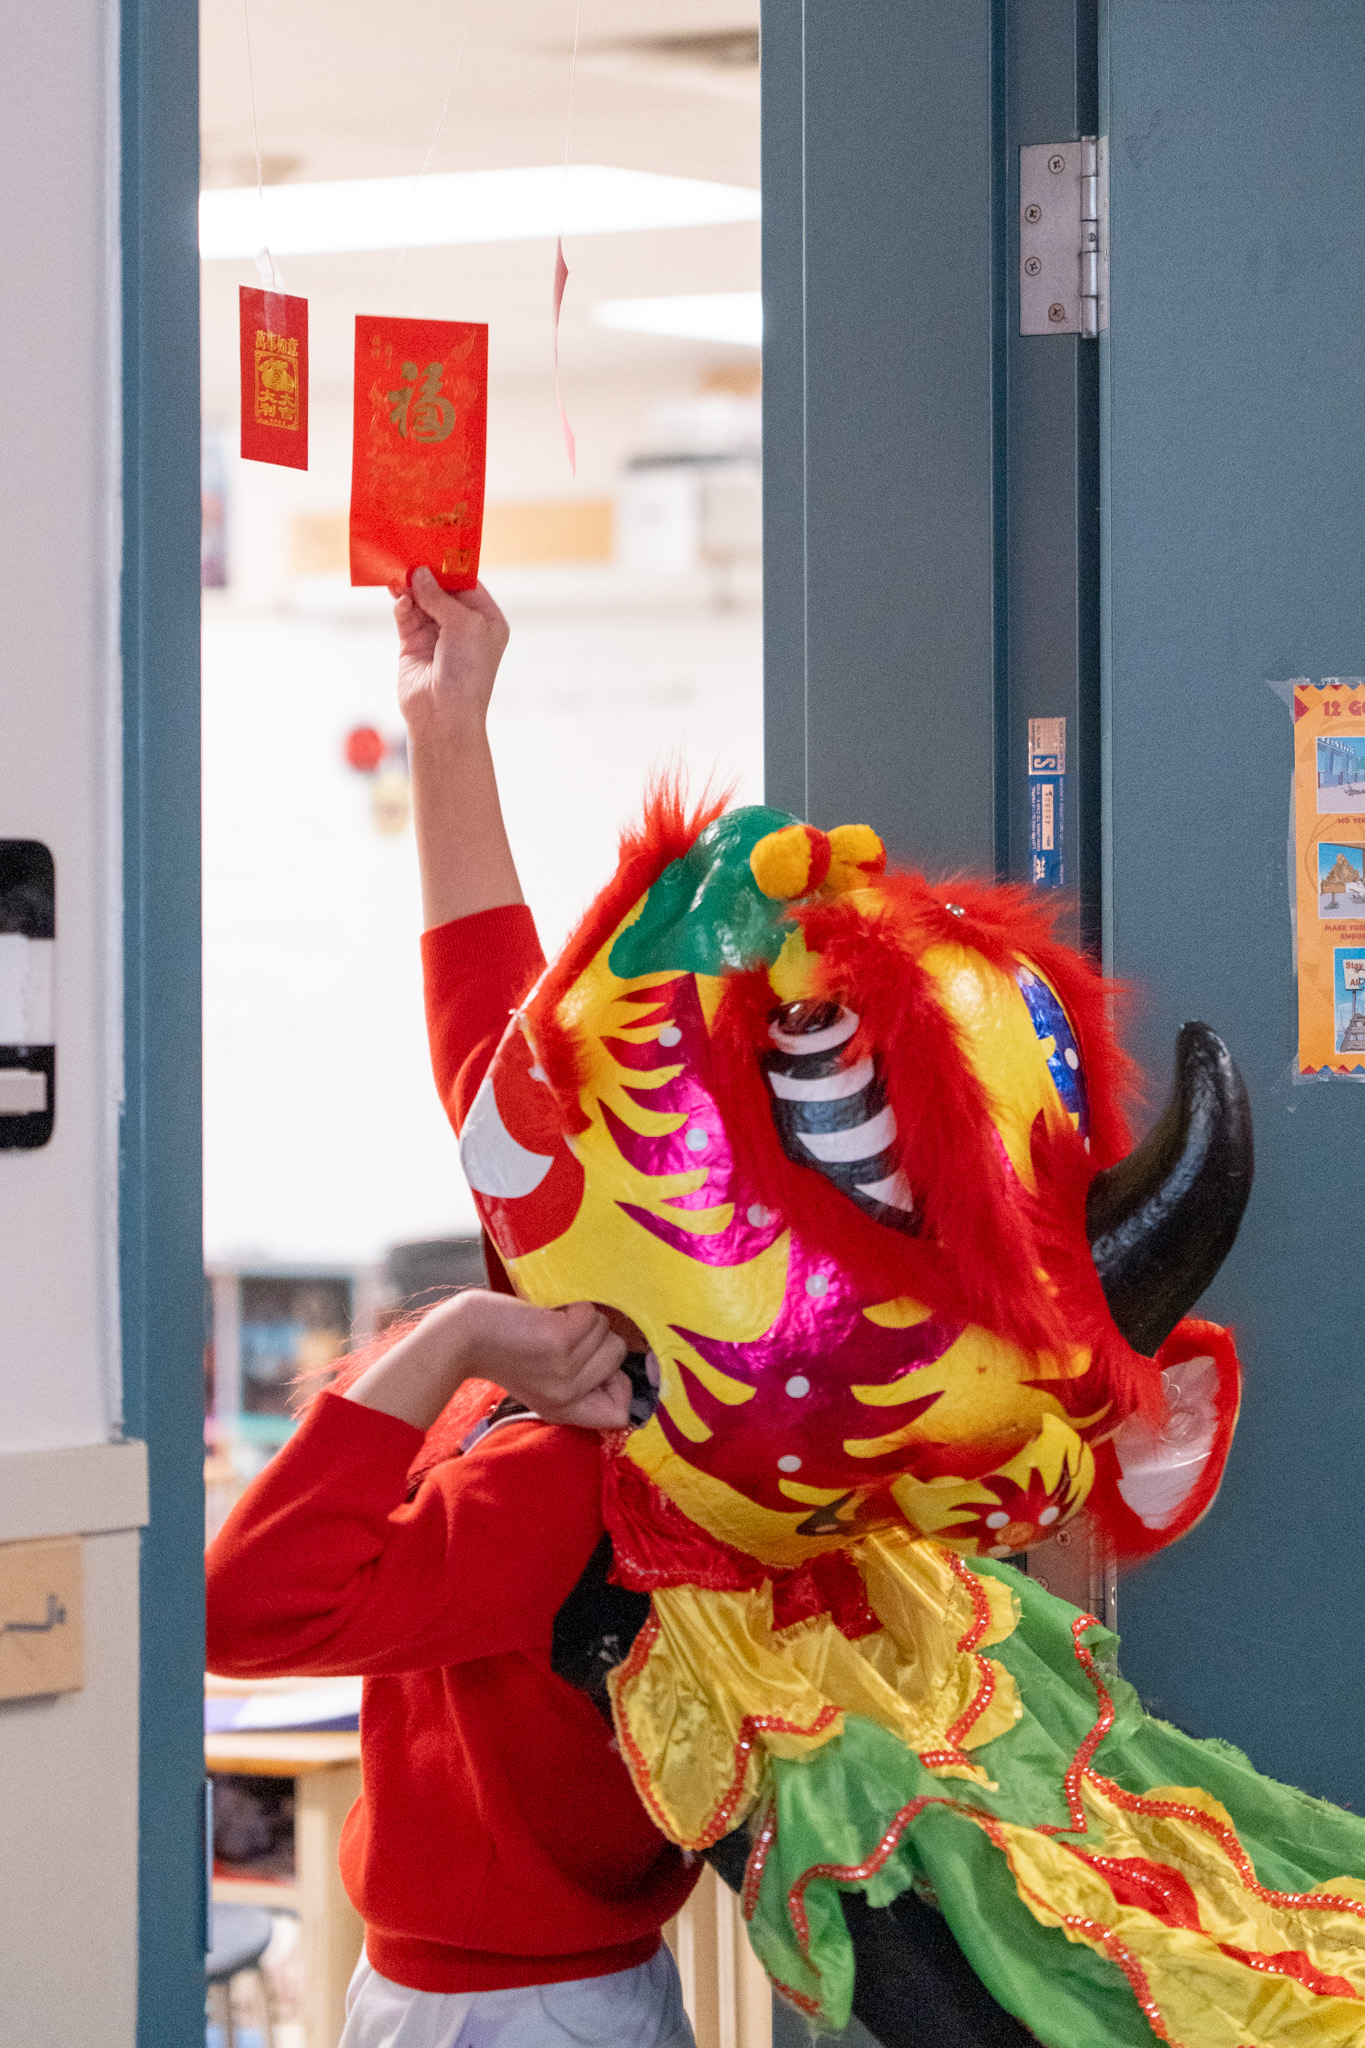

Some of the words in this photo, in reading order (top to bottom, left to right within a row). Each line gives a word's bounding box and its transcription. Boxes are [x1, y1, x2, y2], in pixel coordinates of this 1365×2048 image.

[387, 360, 456, 443] 福
[1322, 700, 1341, 716] 12
[1348, 700, 1365, 716] G
[1034, 758, 1056, 768] S
